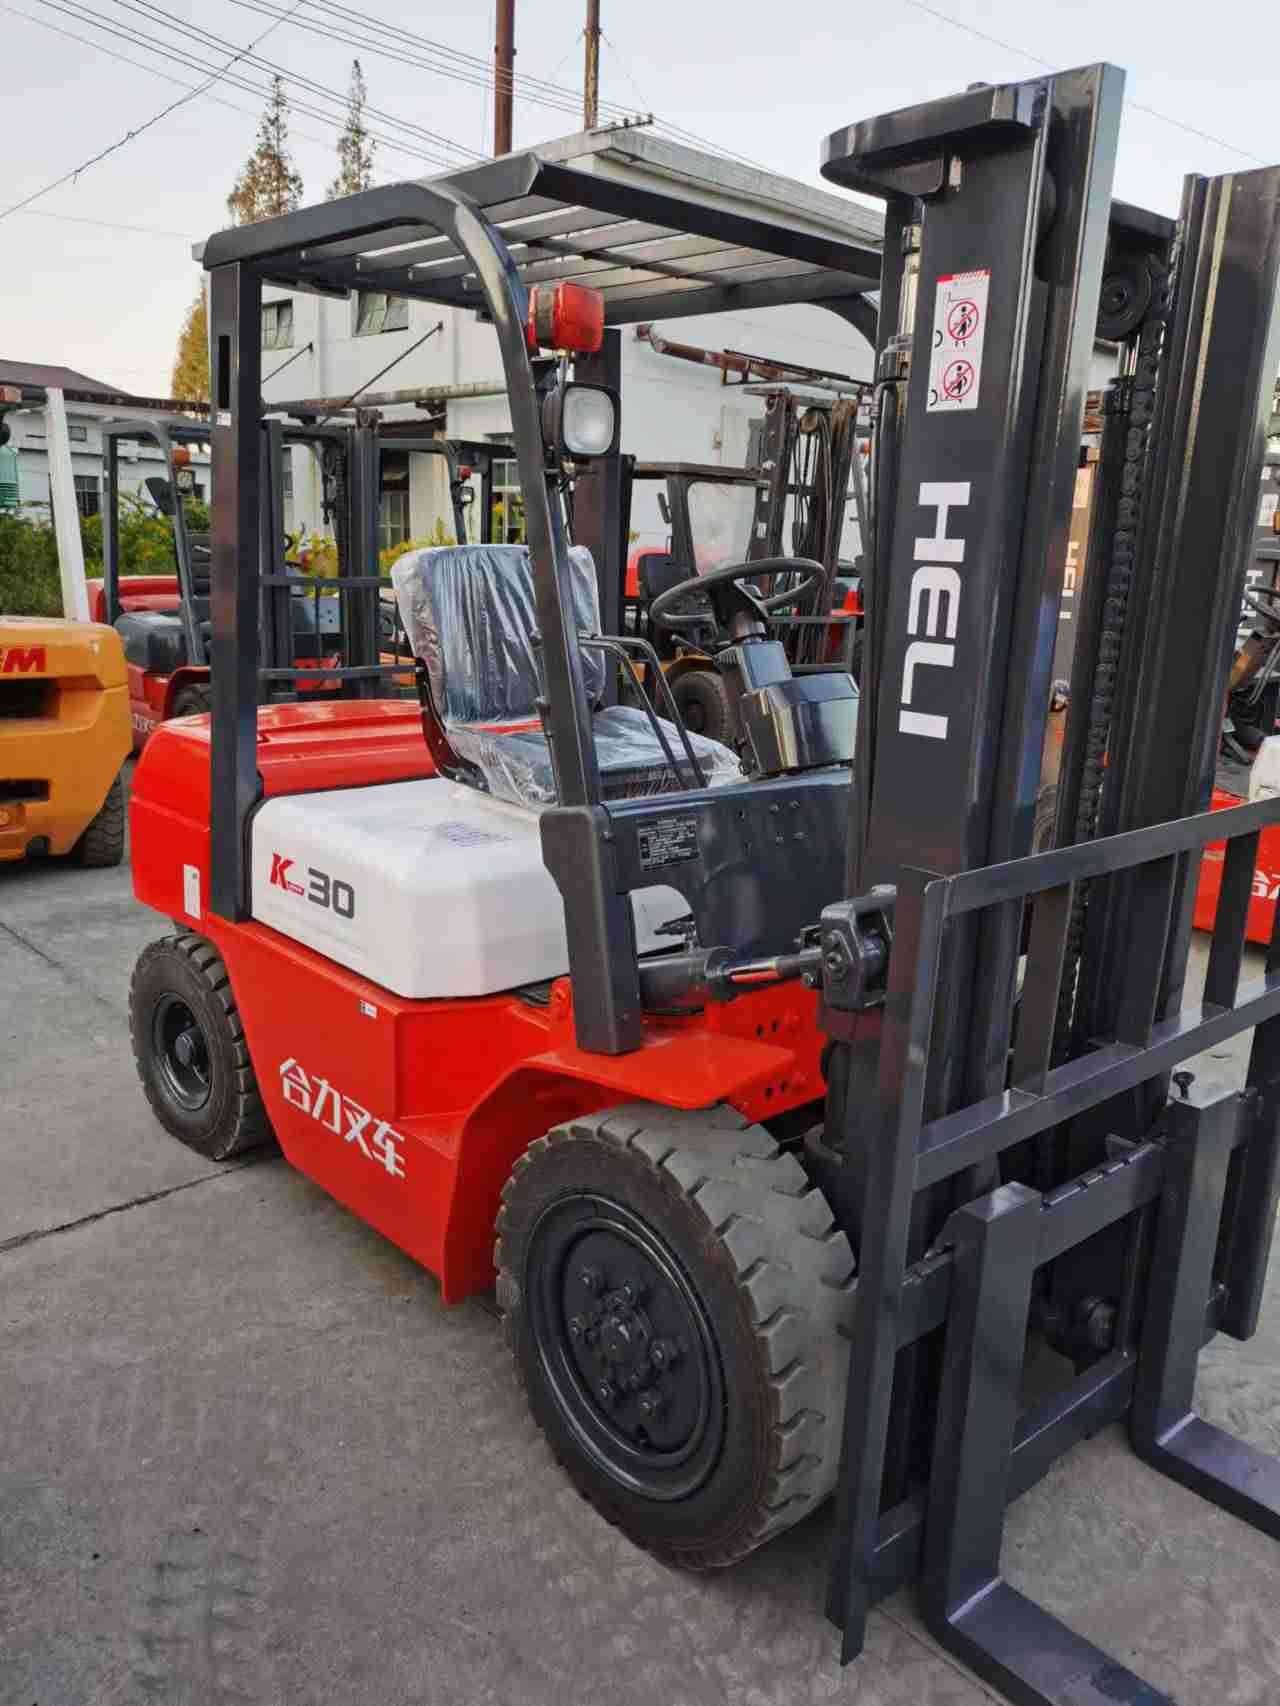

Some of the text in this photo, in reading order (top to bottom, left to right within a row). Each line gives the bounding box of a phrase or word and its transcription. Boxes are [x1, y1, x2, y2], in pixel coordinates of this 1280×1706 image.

[0, 647, 47, 673] M
[898, 481, 971, 740] HELI
[279, 1056, 406, 1179] 合力叉车
